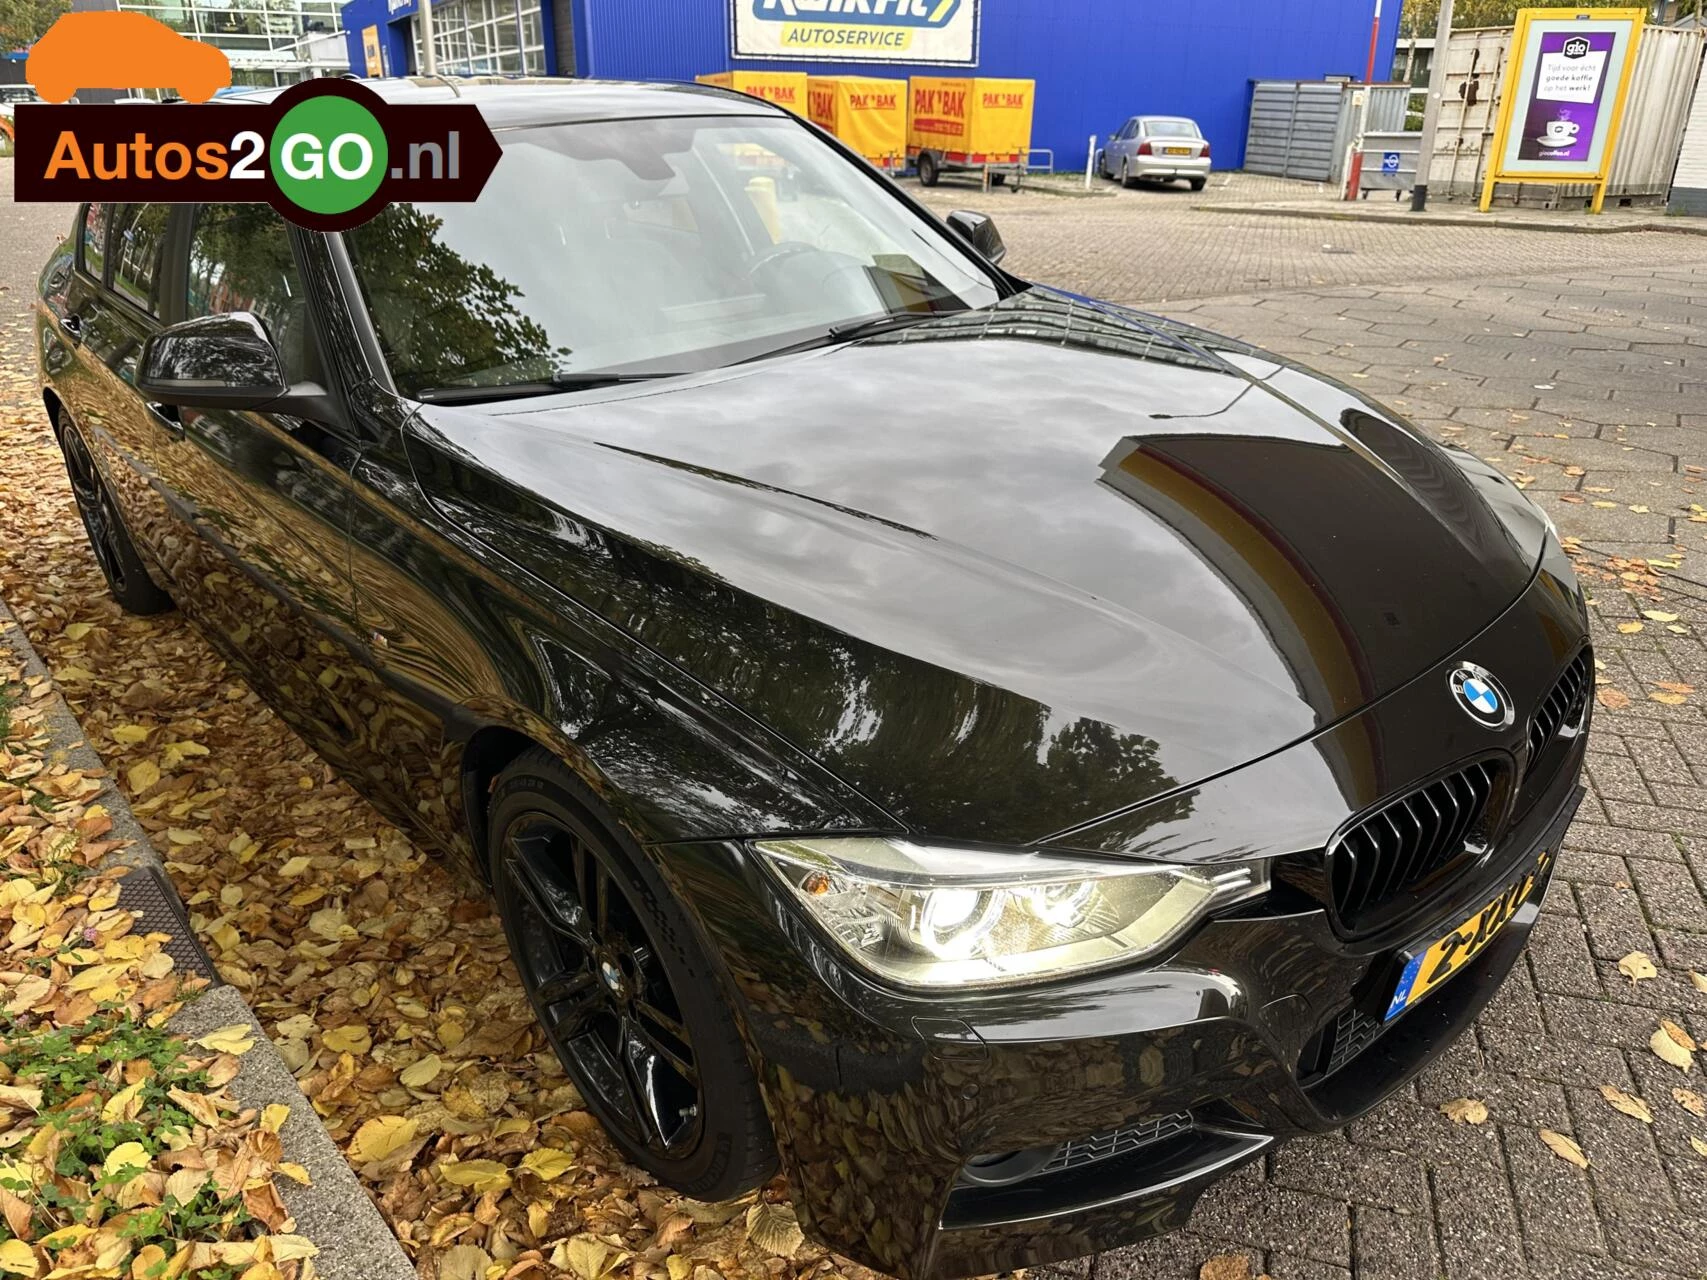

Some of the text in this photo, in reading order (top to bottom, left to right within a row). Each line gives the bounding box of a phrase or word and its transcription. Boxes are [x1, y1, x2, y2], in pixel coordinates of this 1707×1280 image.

[788, 28, 905, 46] AUTOSERVICE
[1546, 74, 1569, 83] goede
[914, 88, 936, 114] PAK
[942, 90, 966, 118] BAK
[1390, 989, 1408, 1009] NL
